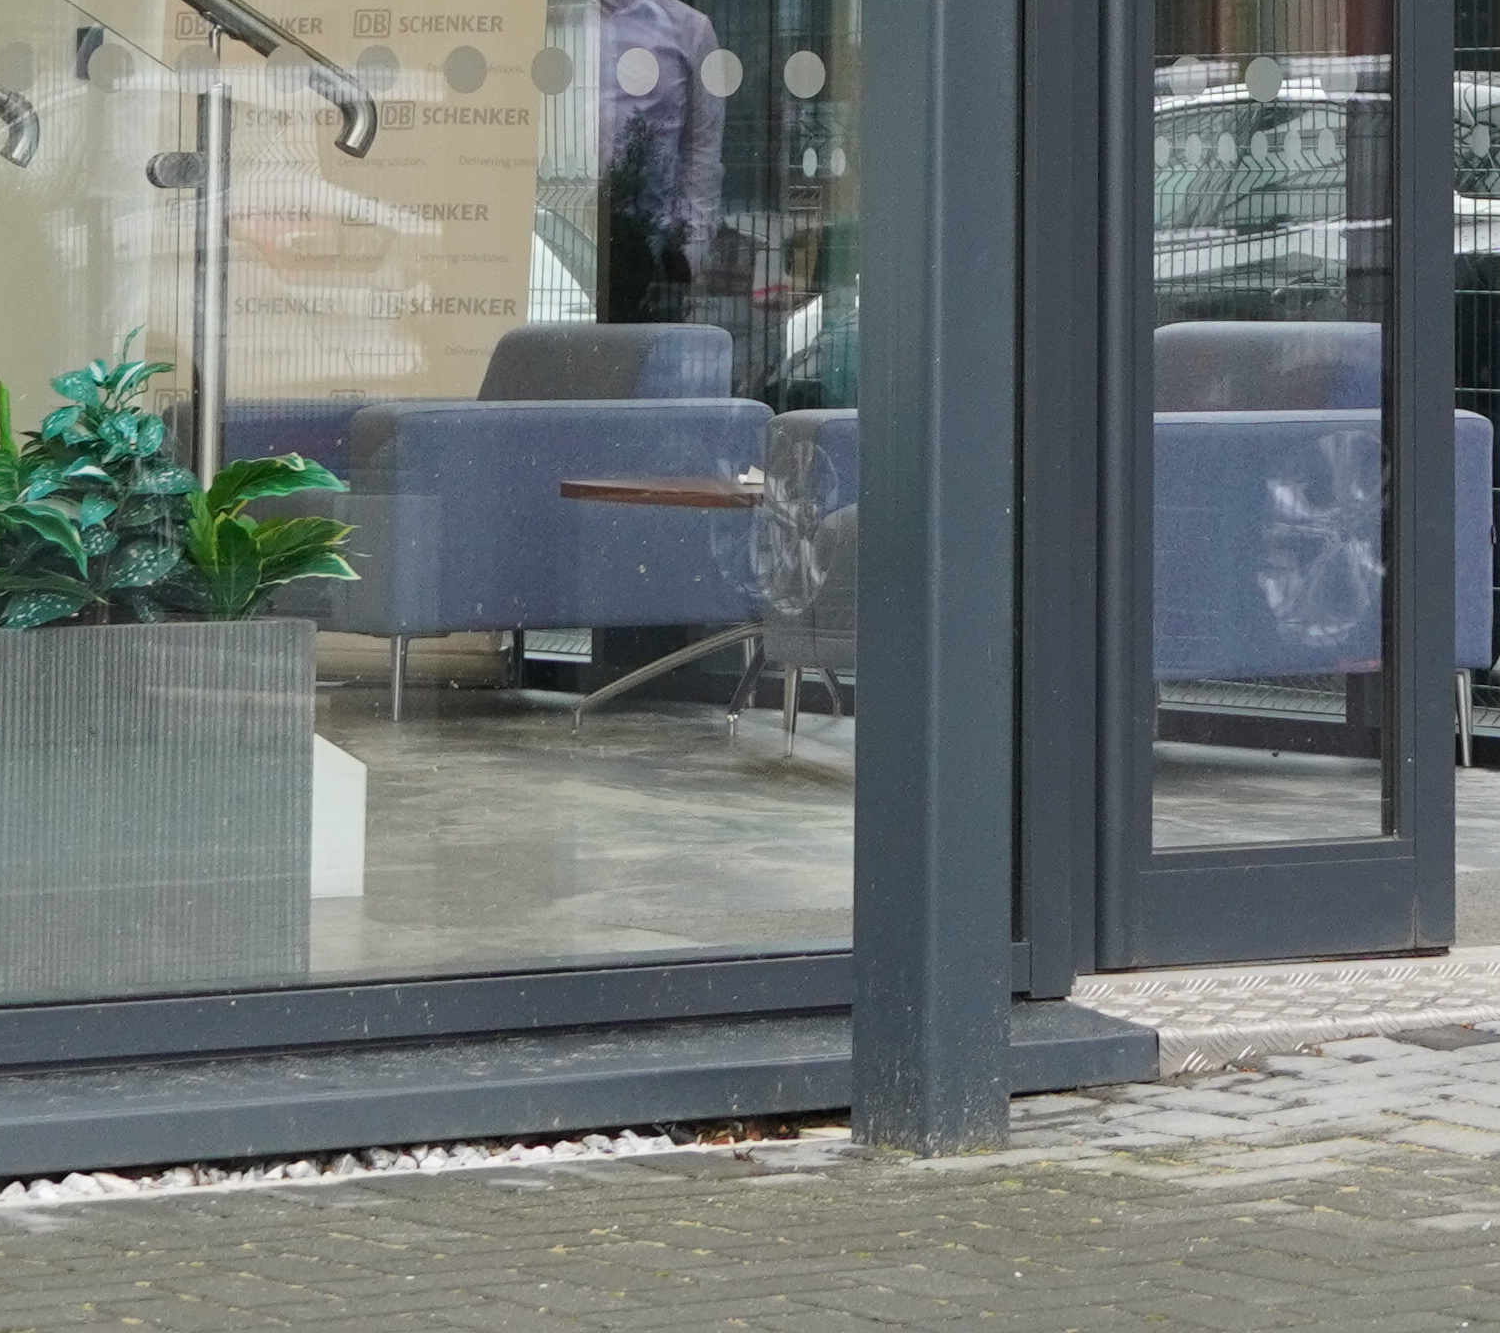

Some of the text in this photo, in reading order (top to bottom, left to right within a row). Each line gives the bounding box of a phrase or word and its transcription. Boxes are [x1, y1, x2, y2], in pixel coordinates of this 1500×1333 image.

[357, 12, 504, 33] DB SCHENKER
[383, 104, 530, 127] DB SCHENKER
[459, 155, 510, 168] Delivering
[409, 297, 517, 317] SCHENKER
